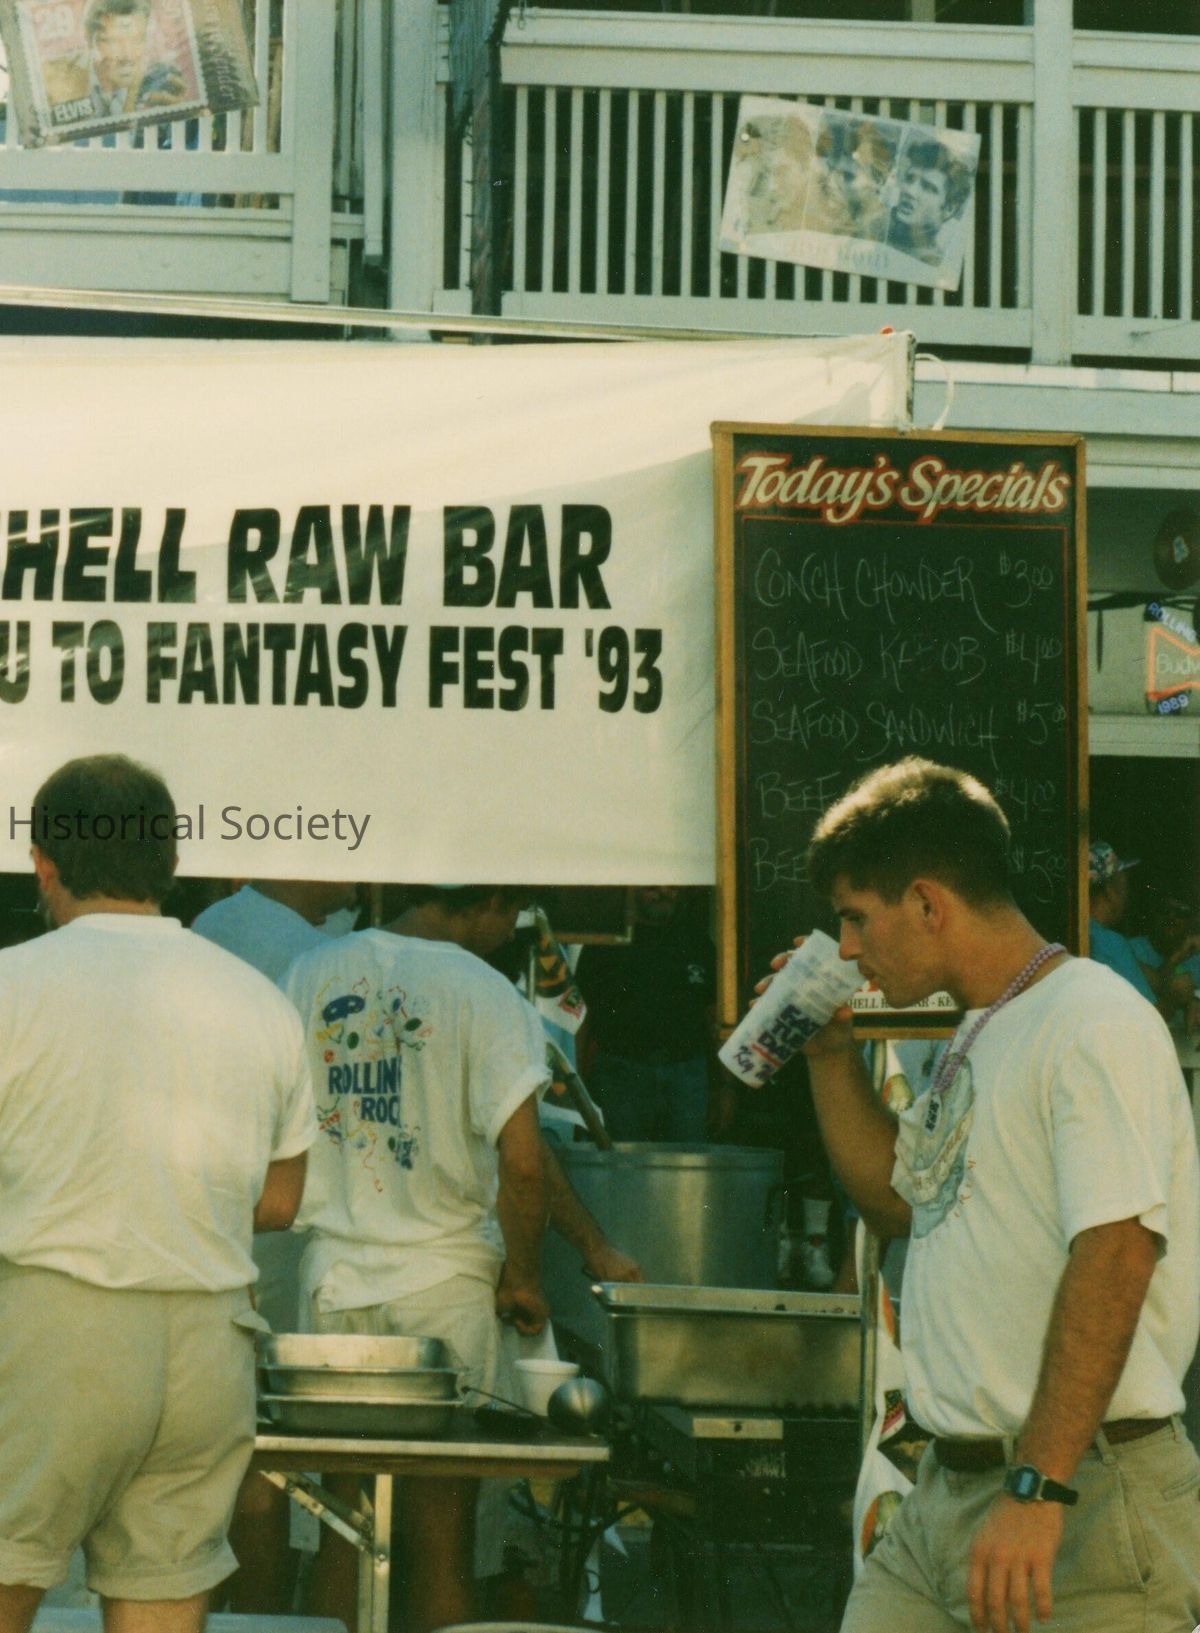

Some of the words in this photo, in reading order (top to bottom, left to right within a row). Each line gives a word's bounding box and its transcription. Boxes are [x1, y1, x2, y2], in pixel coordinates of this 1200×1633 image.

[54, 102, 94, 123] ELVIS
[736, 453, 901, 525] Today's
[900, 455, 1072, 521] Specials
[227, 504, 411, 606] RAW
[443, 503, 613, 610] BAR
[753, 547, 849, 622] CONCH
[855, 552, 999, 635] CHOWDER
[52, 620, 125, 705] TO
[146, 621, 408, 709] FANTASY
[428, 625, 563, 712] FEST
[585, 625, 664, 714] '93
[752, 626, 863, 693] SEAFOOD
[752, 697, 860, 750] SEAFOOD
[848, 997, 878, 1009] HELL
